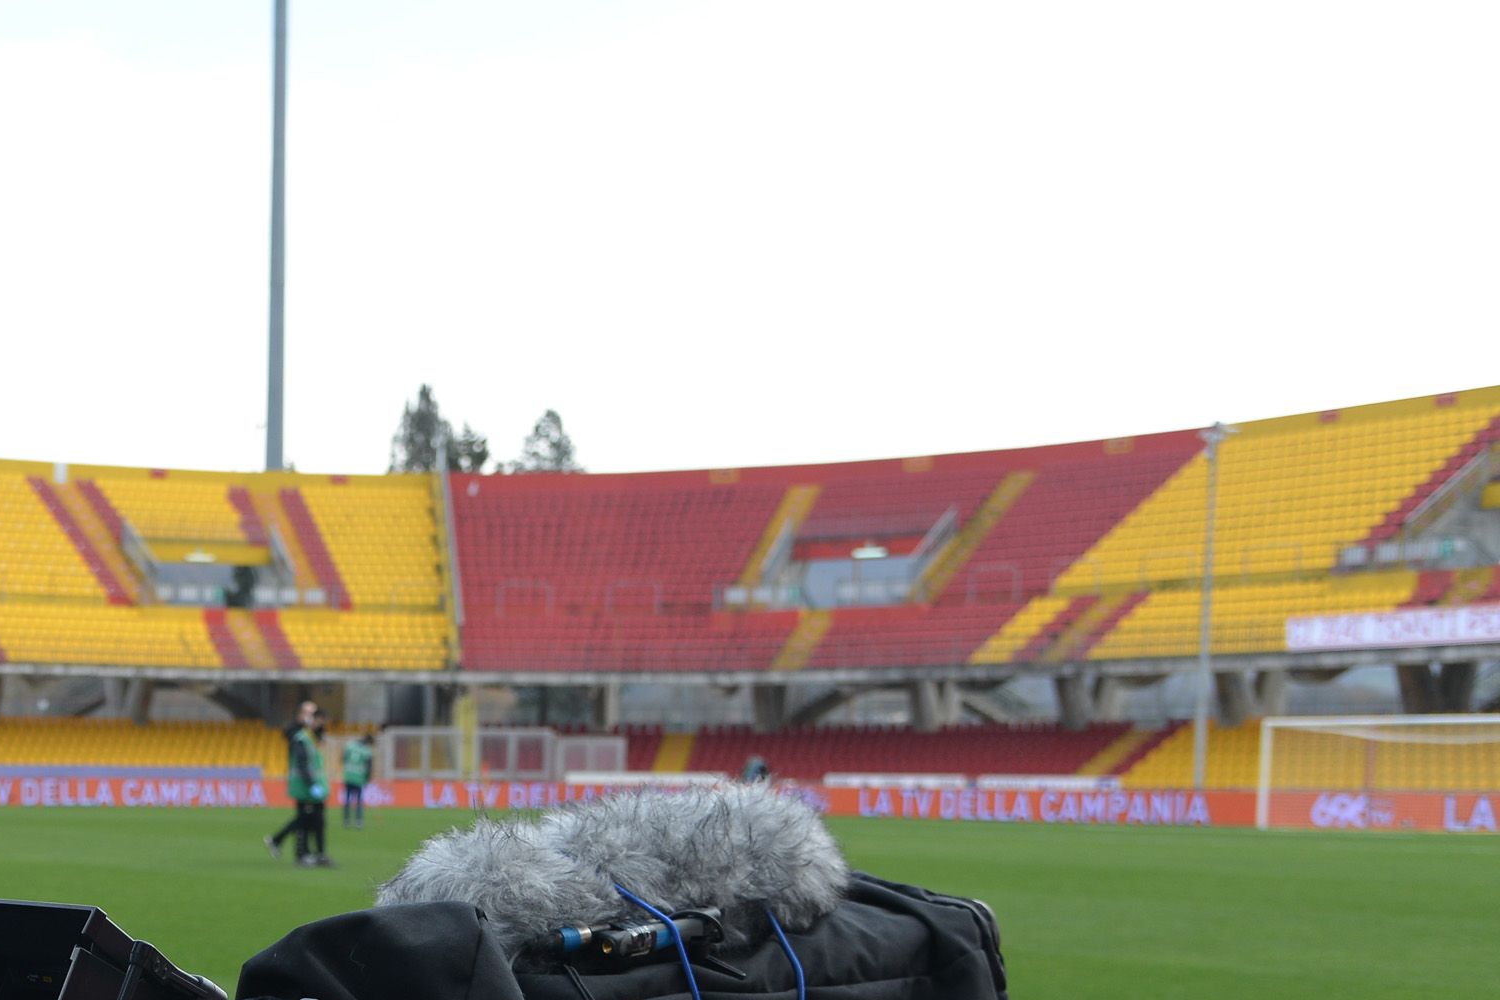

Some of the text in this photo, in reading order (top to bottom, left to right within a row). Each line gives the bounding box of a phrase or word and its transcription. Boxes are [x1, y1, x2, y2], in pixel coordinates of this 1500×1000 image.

[20, 777, 115, 808] DELLA
[121, 777, 267, 808] CAMPANIA
[423, 782, 459, 810] LA
[464, 782, 501, 810] TV
[859, 788, 895, 819] LA
[900, 788, 933, 819] TV
[938, 788, 1034, 822] DELLA
[1039, 789, 1211, 826] CAMPANIA
[1444, 792, 1498, 832] LA
